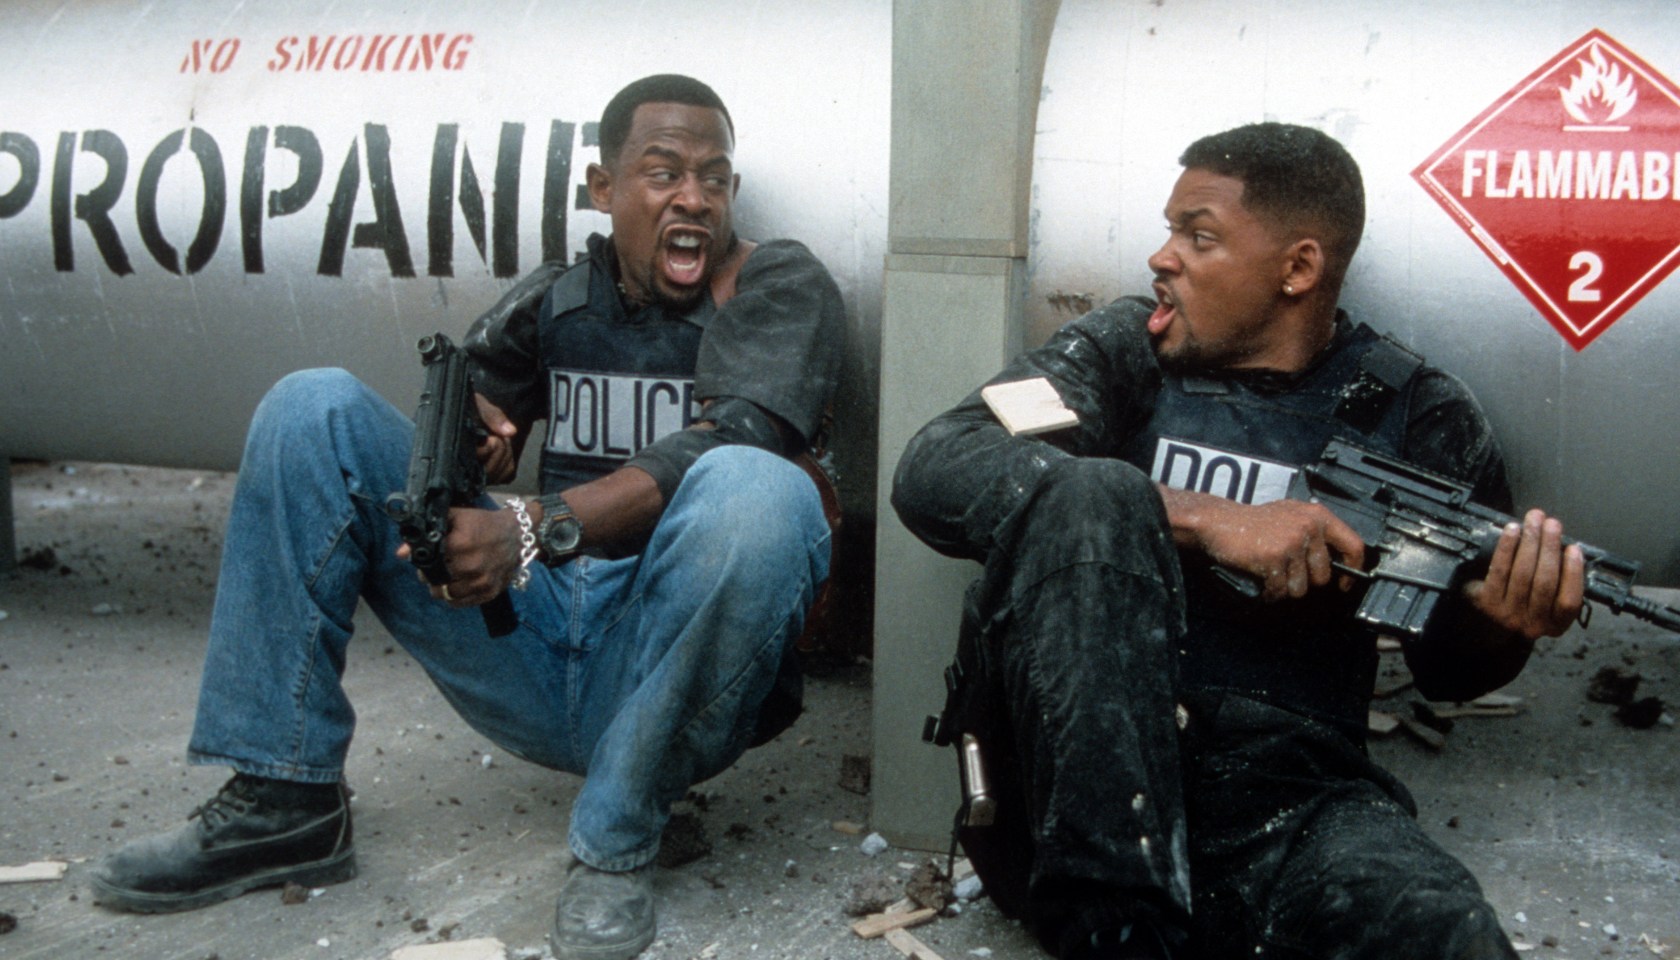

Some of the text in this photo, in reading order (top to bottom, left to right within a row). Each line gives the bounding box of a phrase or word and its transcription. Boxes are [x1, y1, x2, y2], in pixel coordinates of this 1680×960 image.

[180, 33, 474, 74] NO SMOKING
[1462, 150, 1680, 200] FLAMMAB
[1567, 251, 1604, 302] 2
